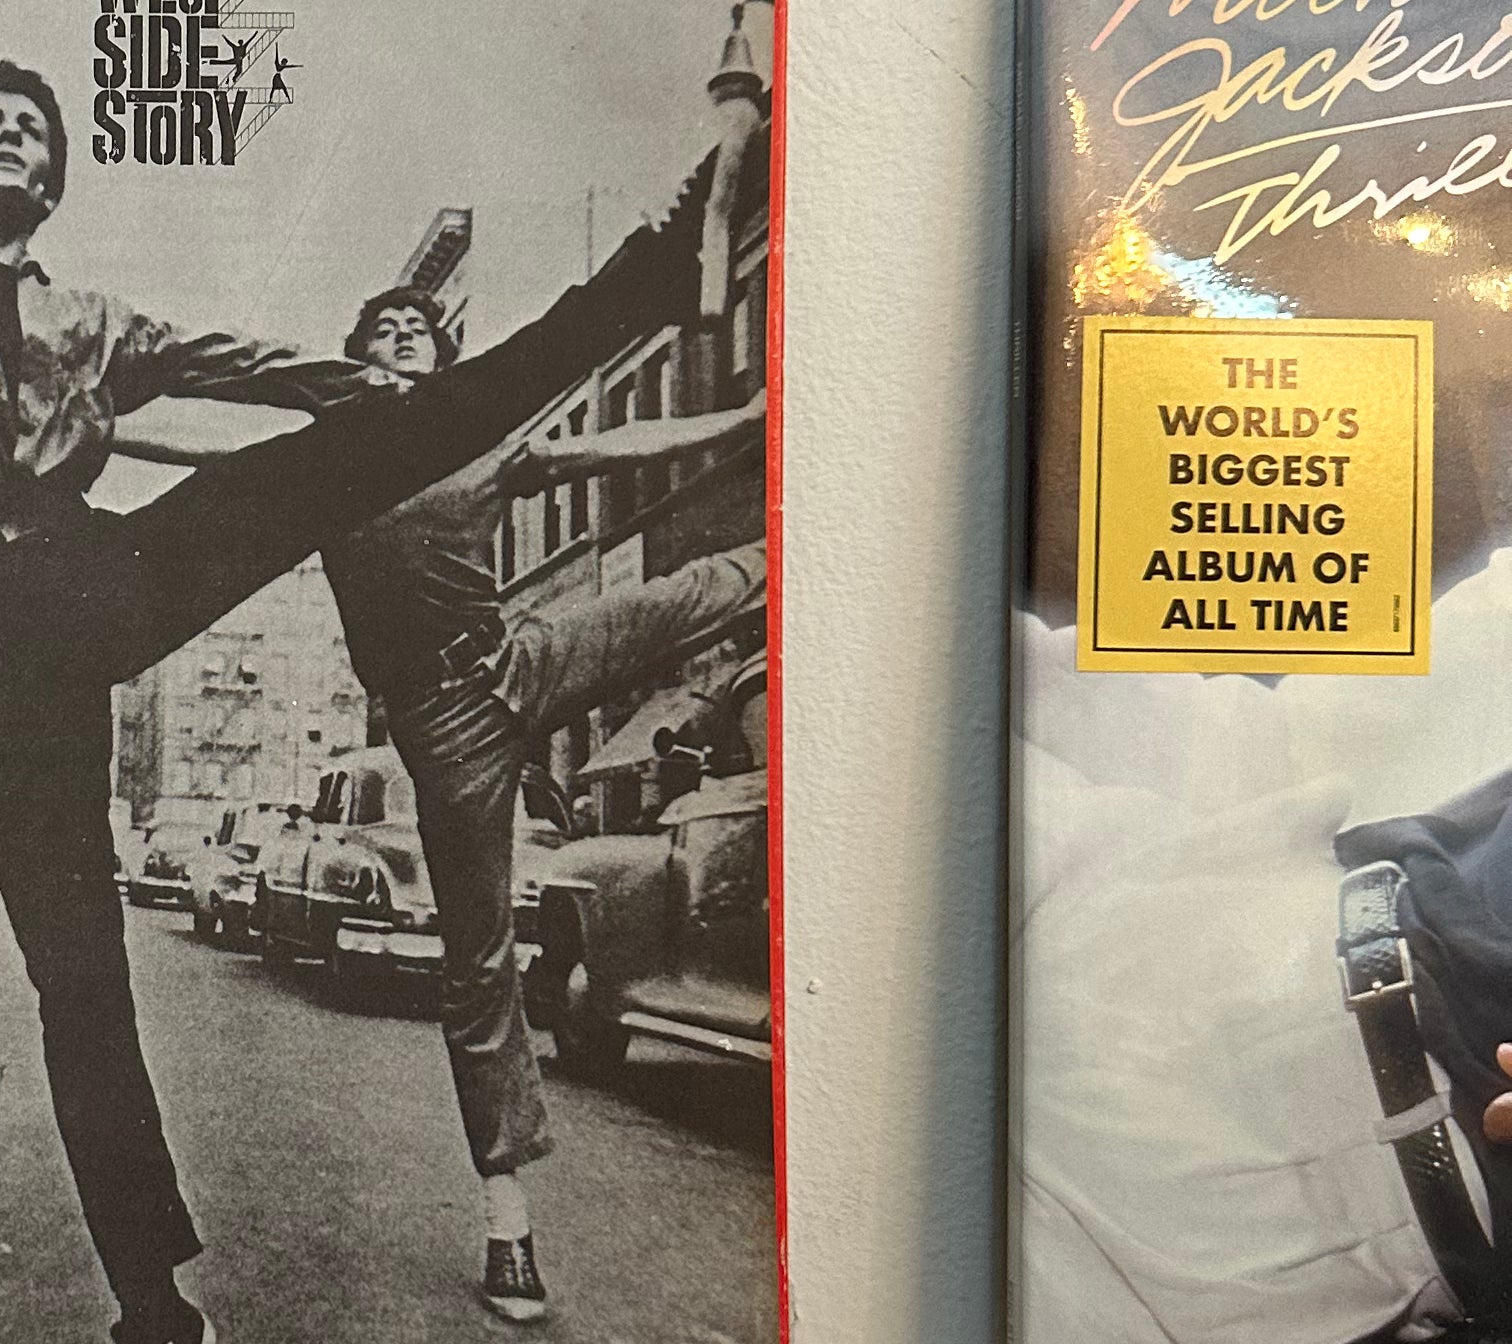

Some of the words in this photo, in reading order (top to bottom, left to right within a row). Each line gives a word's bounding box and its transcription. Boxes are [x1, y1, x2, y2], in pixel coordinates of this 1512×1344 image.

[92, 14, 220, 89] SIDE
[92, 89, 248, 166] STORY
[1222, 357, 1298, 390] THE
[1157, 404, 1360, 440] WORLD'S
[1168, 453, 1350, 488] BIGGEST
[1169, 501, 1346, 536] SELLING
[1141, 550, 1296, 583] ALBUM
[1312, 552, 1369, 585] OF
[1160, 598, 1237, 631] ALL
[1249, 599, 1349, 632] TIME
